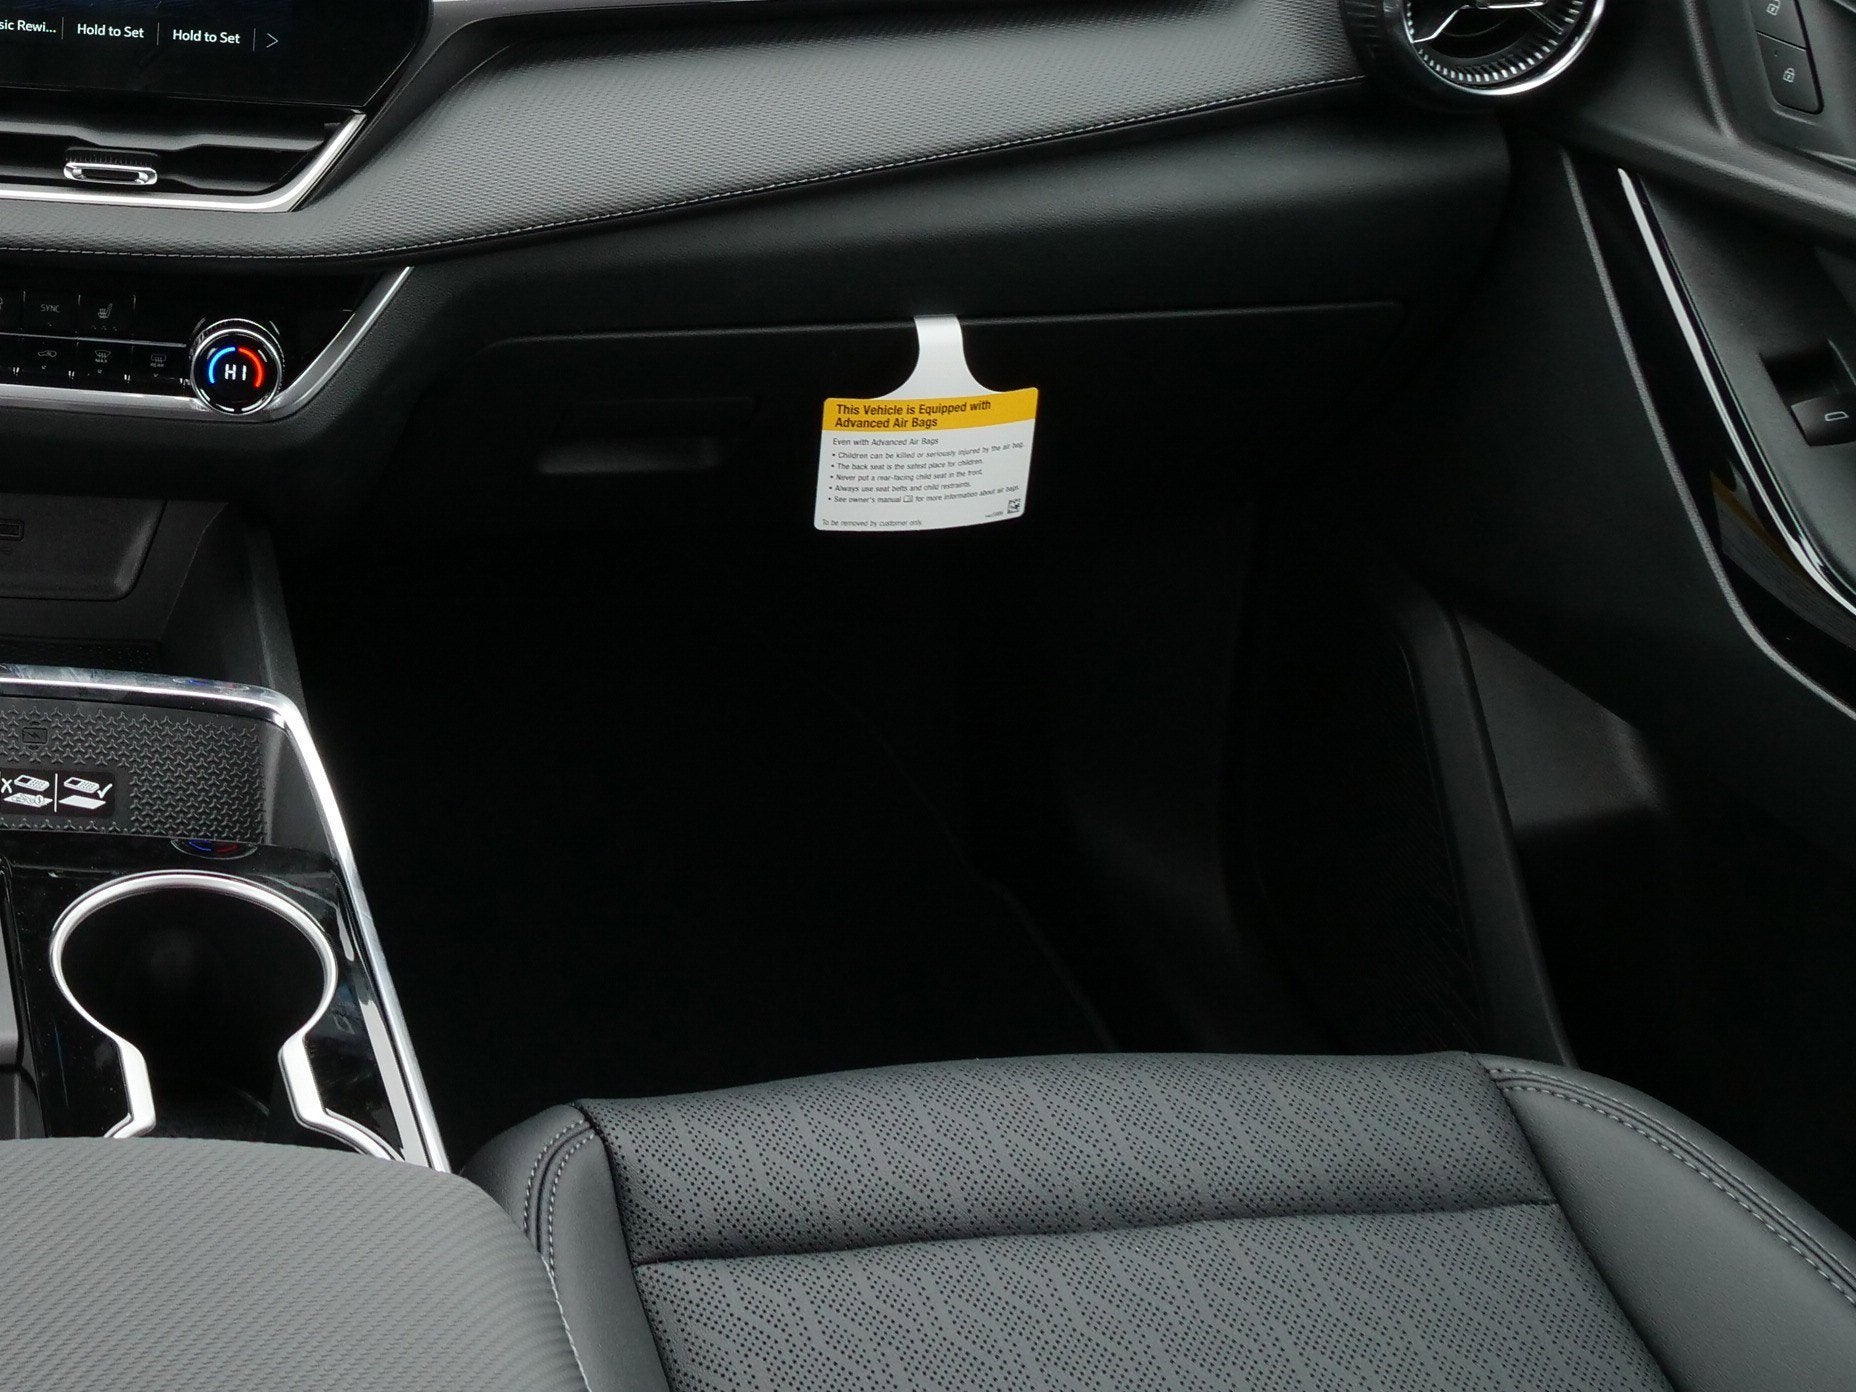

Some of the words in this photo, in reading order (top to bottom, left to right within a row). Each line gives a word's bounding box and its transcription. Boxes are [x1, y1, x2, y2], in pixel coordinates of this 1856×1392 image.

[17, 20, 58, 34] Rewi...
[77, 23, 105, 37] Hold
[108, 26, 122, 37] to
[124, 26, 145, 39] Set
[173, 29, 202, 42] Hold
[204, 32, 217, 43] to
[220, 32, 241, 45] Set
[39, 303, 61, 313] SYNC
[224, 363, 248, 382] HI
[837, 404, 860, 415] This
[863, 404, 904, 415] Vehicle
[906, 404, 916, 415] is
[919, 402, 967, 415] Equipped
[970, 400, 991, 411] with
[835, 417, 890, 429] Advanced
[893, 417, 908, 428] Air
[911, 417, 938, 429] Bags
[833, 438, 851, 446] Even
[853, 438, 869, 446] with
[872, 438, 907, 446] Advanced
[909, 438, 919, 446] Air
[921, 437, 939, 446] Bags
[838, 451, 868, 459] Children
